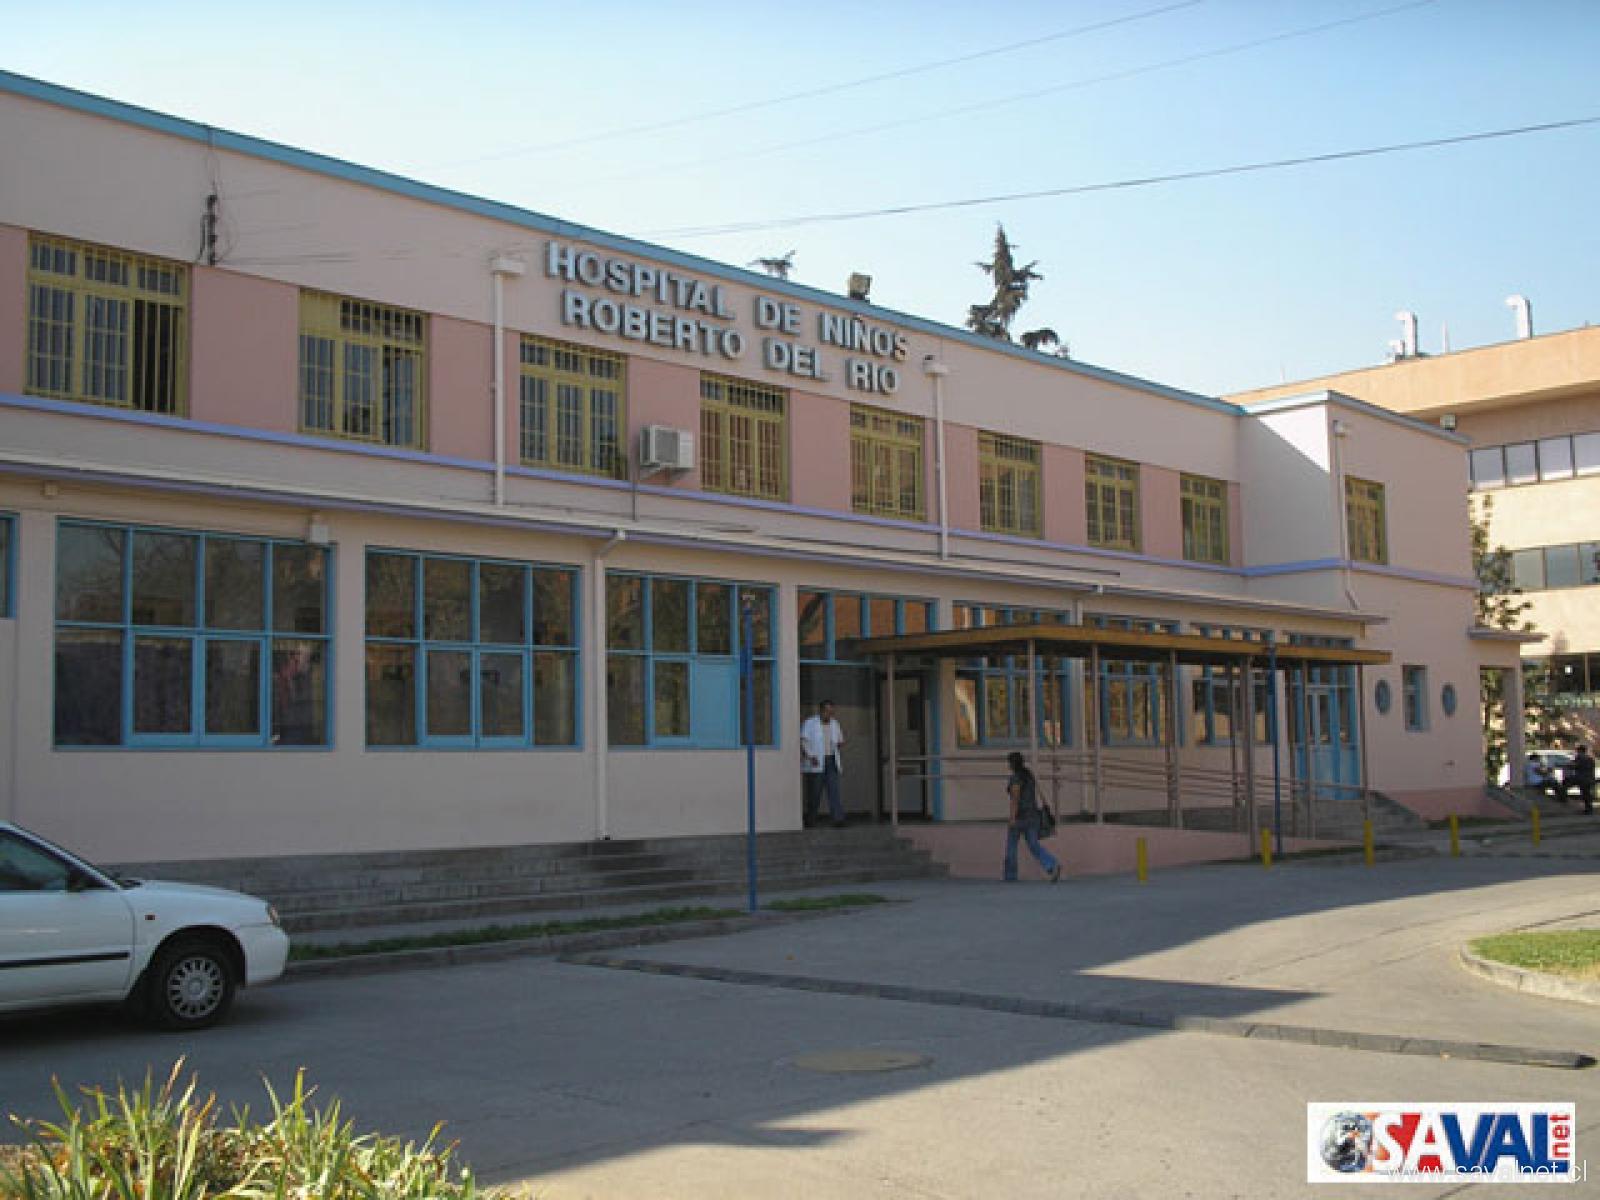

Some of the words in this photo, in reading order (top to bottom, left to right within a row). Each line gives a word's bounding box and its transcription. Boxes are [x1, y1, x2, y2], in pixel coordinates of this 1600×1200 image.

[546, 241, 733, 320] HOSPITAL
[755, 296, 802, 334] DE
[562, 288, 743, 361] ROBERTO
[763, 336, 829, 382] DEL
[846, 357, 901, 395] RIO
